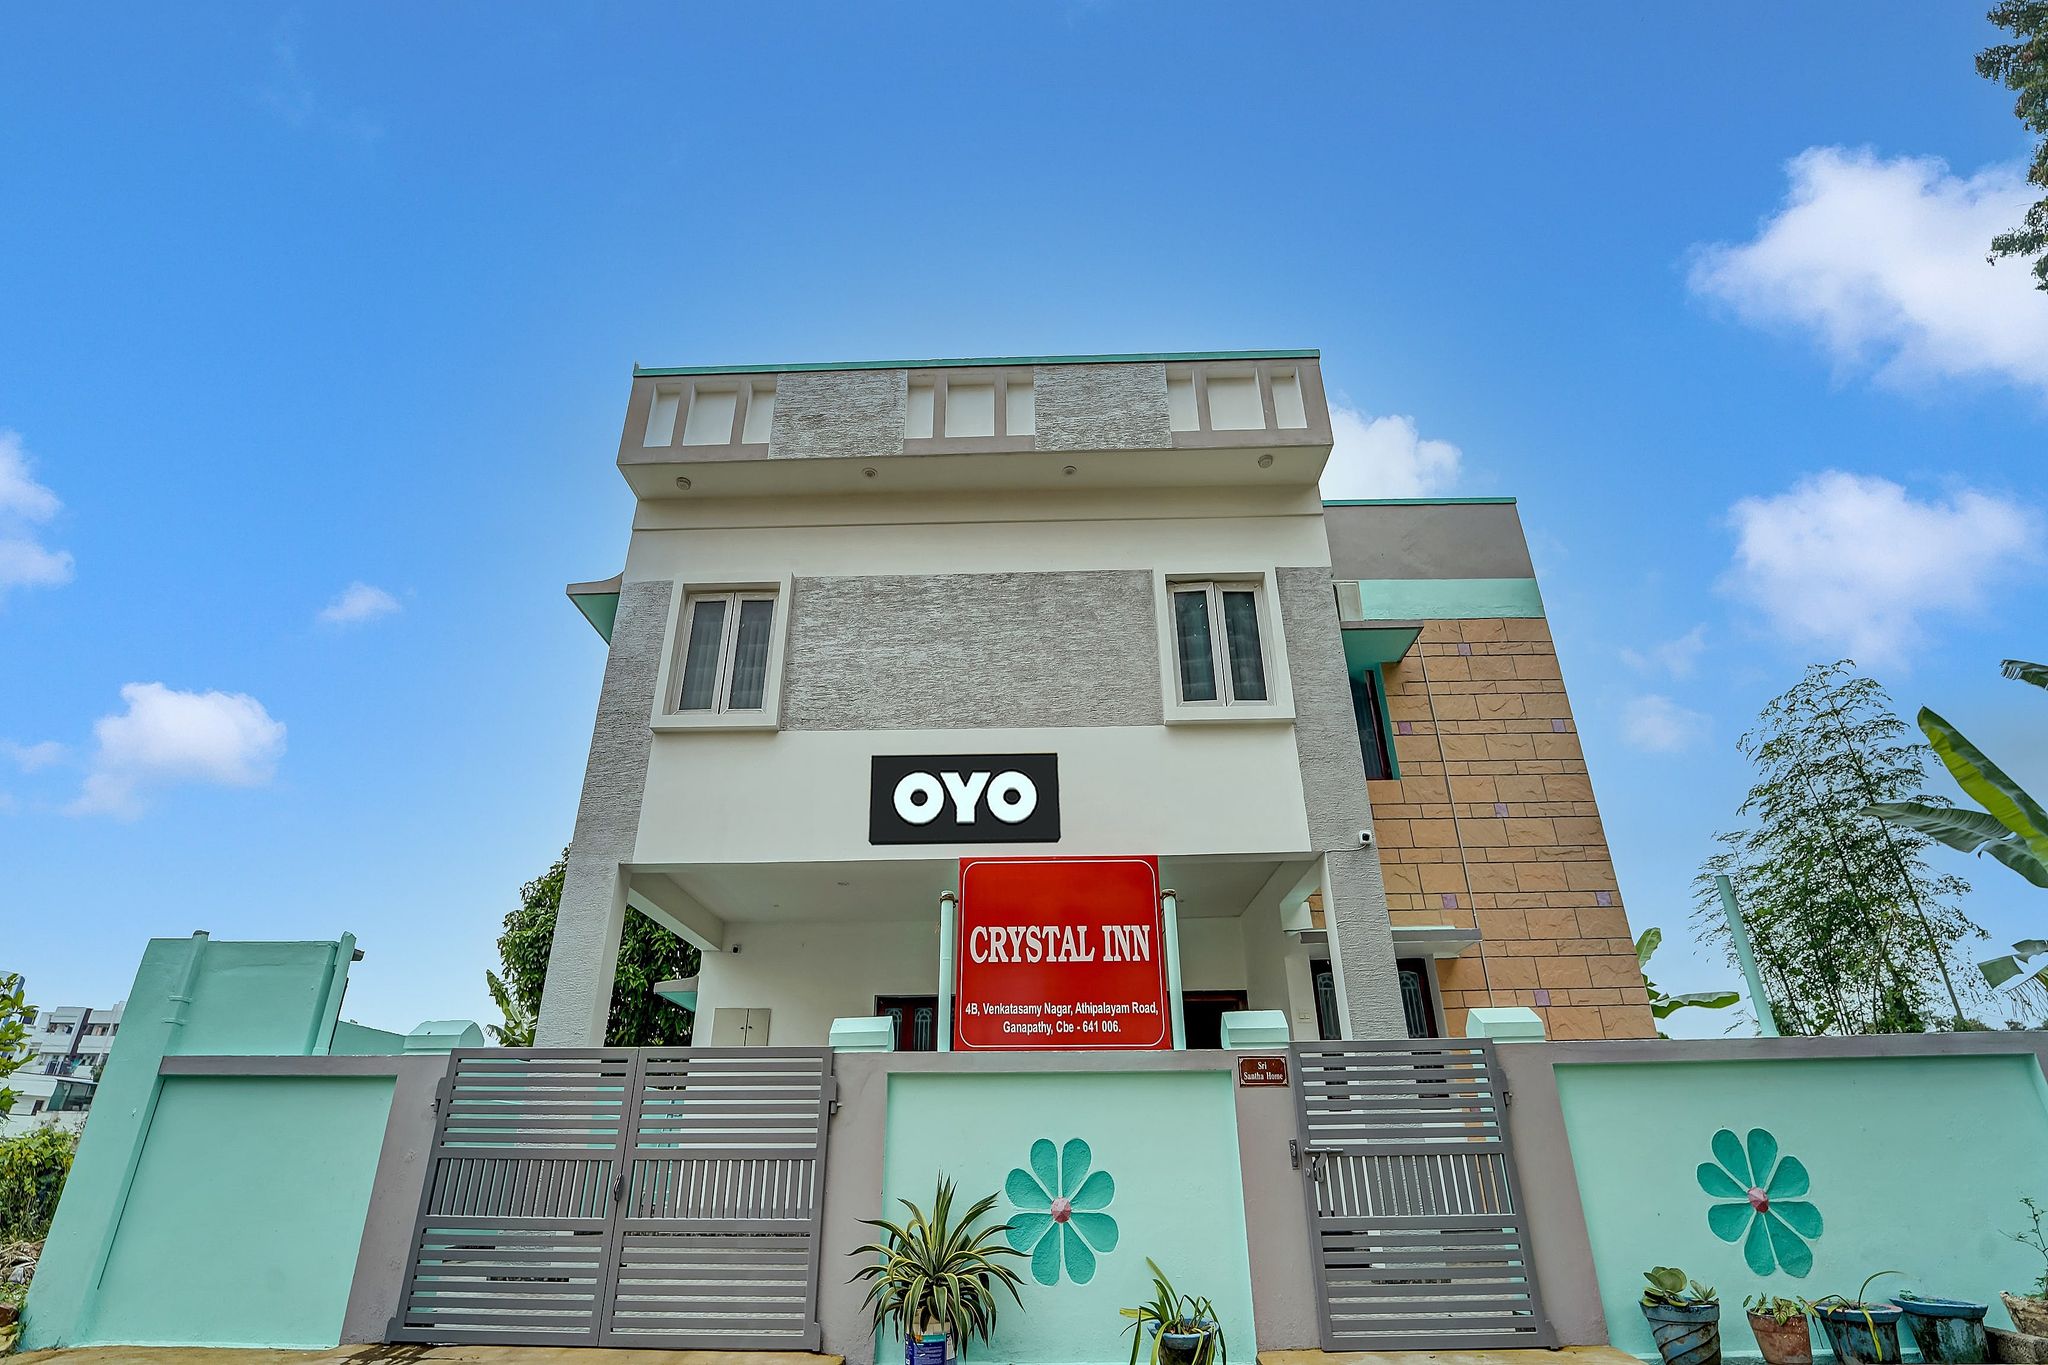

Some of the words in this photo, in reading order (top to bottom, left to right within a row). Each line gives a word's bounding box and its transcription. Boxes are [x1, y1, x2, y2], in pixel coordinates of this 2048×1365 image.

[893, 771, 1037, 824] OYO
[970, 926, 1095, 963] CRYSTAL
[1102, 925, 1150, 962] INN
[965, 1003, 980, 1017] 4B,
[983, 1003, 1042, 1017] Venkatasamy
[1044, 1002, 1073, 1017] Nagar,
[1075, 1002, 1130, 1017] Athipalayam
[1132, 1002, 1159, 1016] Road,
[1003, 1021, 1054, 1035] Ganapathy,
[1056, 1020, 1074, 1033] Cbe
[1083, 1020, 1098, 1033] 641
[1101, 1020, 1122, 1033] 006.
[1257, 1061, 1267, 1070] Sri
[1266, 1071, 1284, 1080] Home
